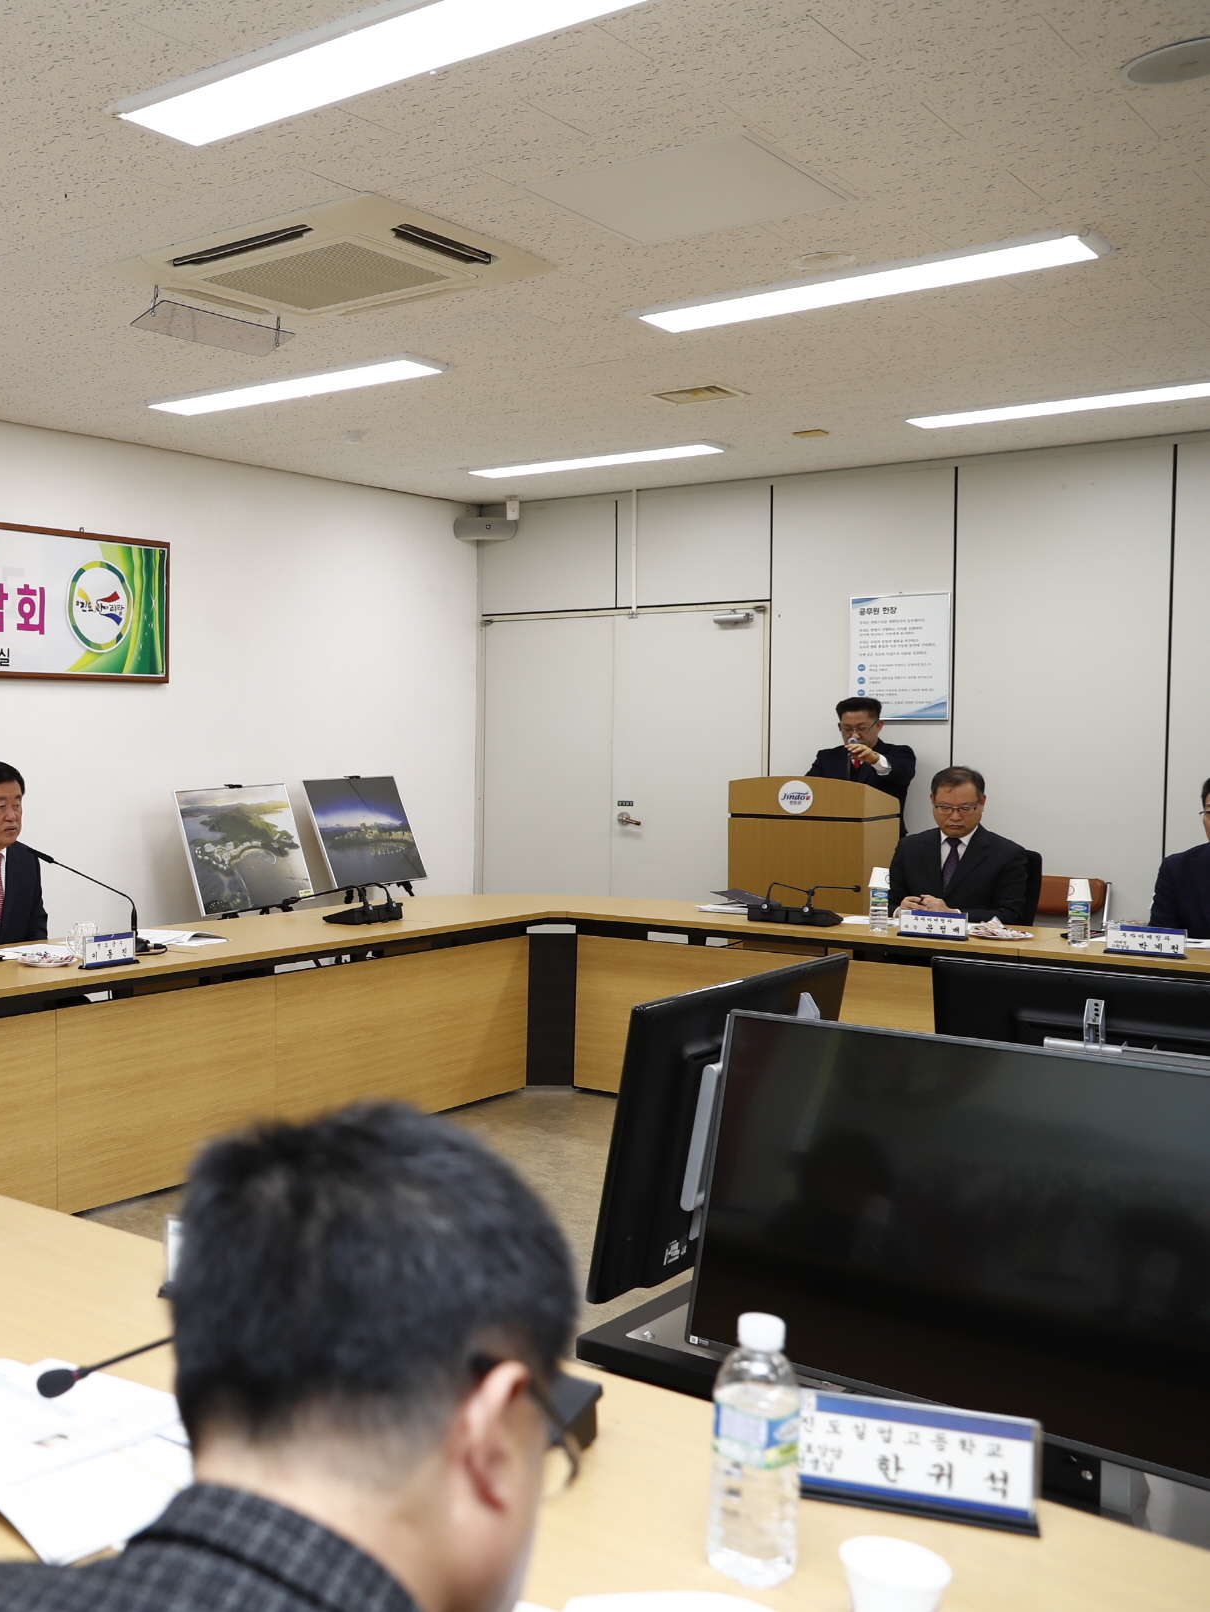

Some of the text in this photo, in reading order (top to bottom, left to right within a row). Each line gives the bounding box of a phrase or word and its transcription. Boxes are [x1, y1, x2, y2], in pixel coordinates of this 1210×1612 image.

[858, 606, 897, 616] 공무원 헌장
[781, 792, 805, 801] Jindo
[92, 948, 127, 961] 이동진
[801, 1416, 1004, 1458] 진도실업고등학교
[876, 1453, 1010, 1500] 한귀석
